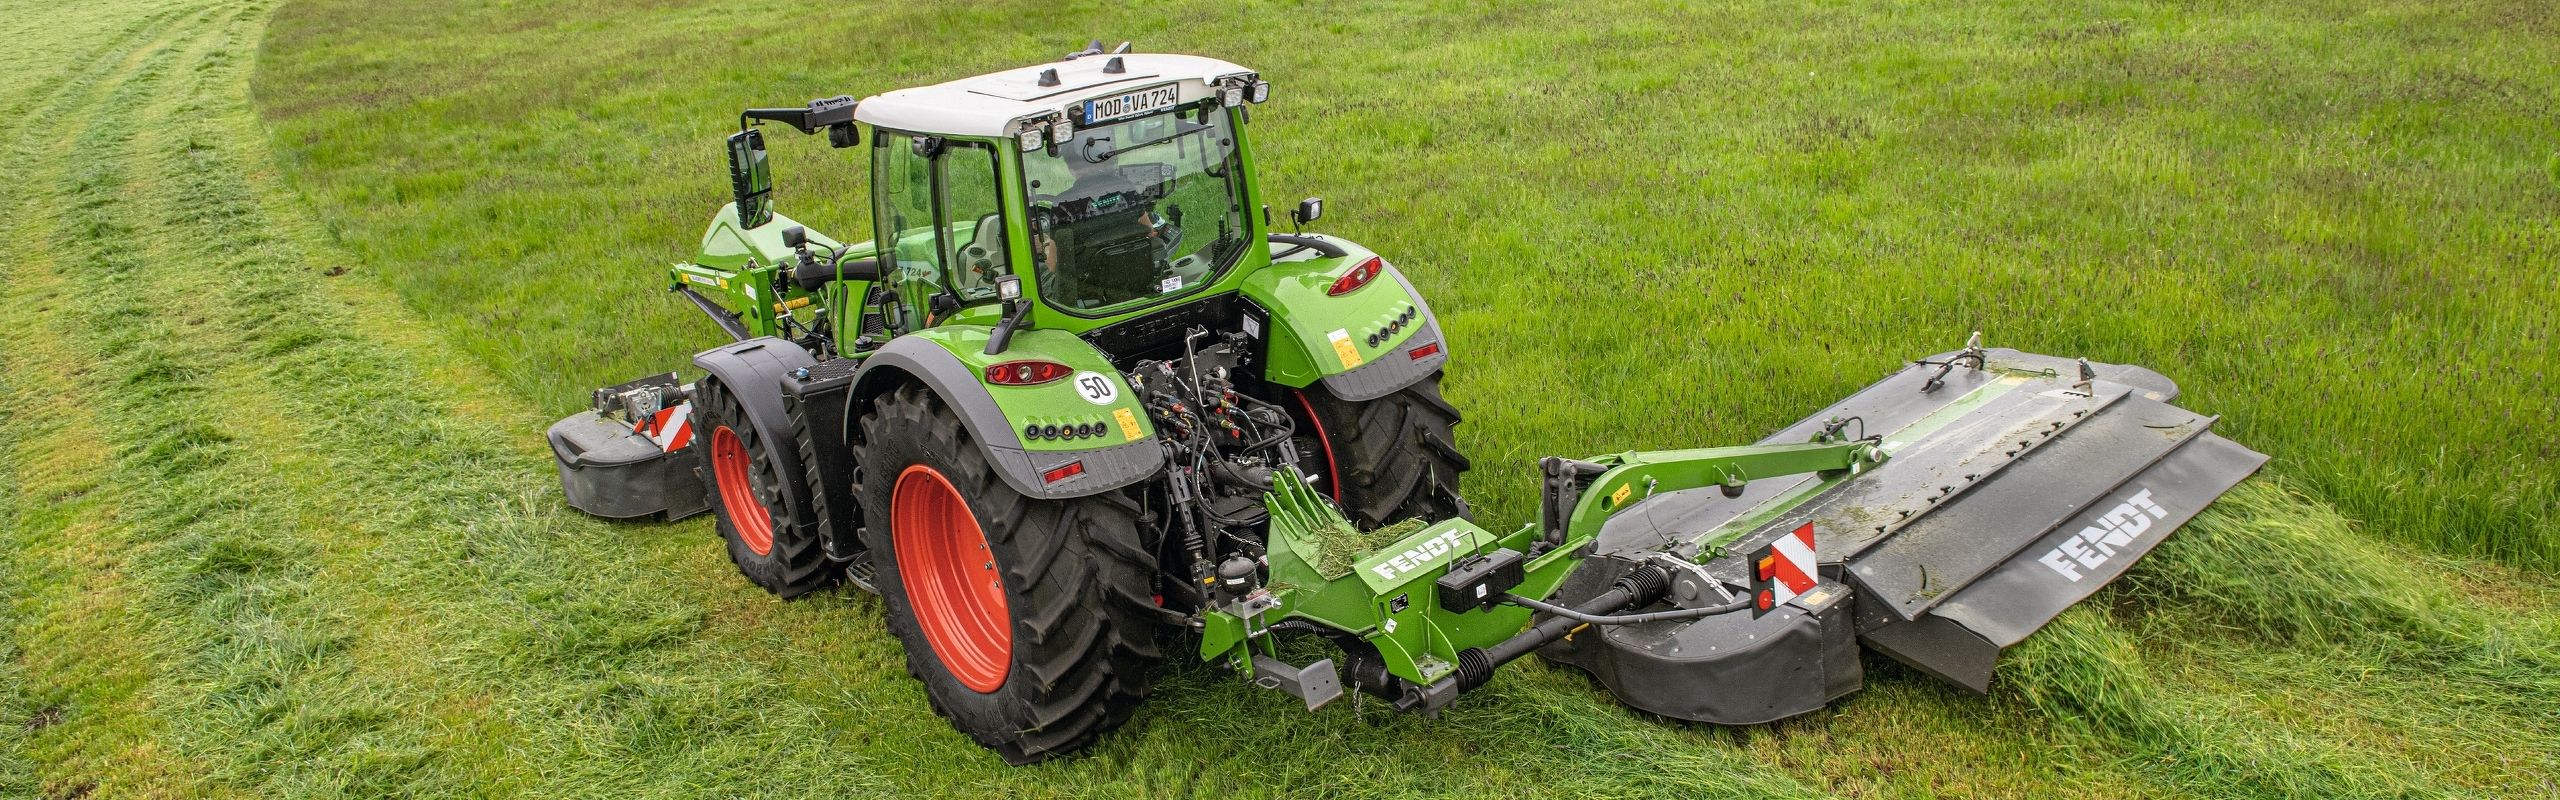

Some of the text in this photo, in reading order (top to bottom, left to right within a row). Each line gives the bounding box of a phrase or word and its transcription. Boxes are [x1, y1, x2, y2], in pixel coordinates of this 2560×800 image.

[1095, 99, 1121, 119] MOD
[1132, 93, 1148, 111] VA
[1152, 88, 1175, 109] 724
[906, 266, 921, 277] 724
[1080, 376, 1111, 399] 50
[2038, 488, 2168, 583] FENDT
[1371, 528, 1461, 580] FENDT
